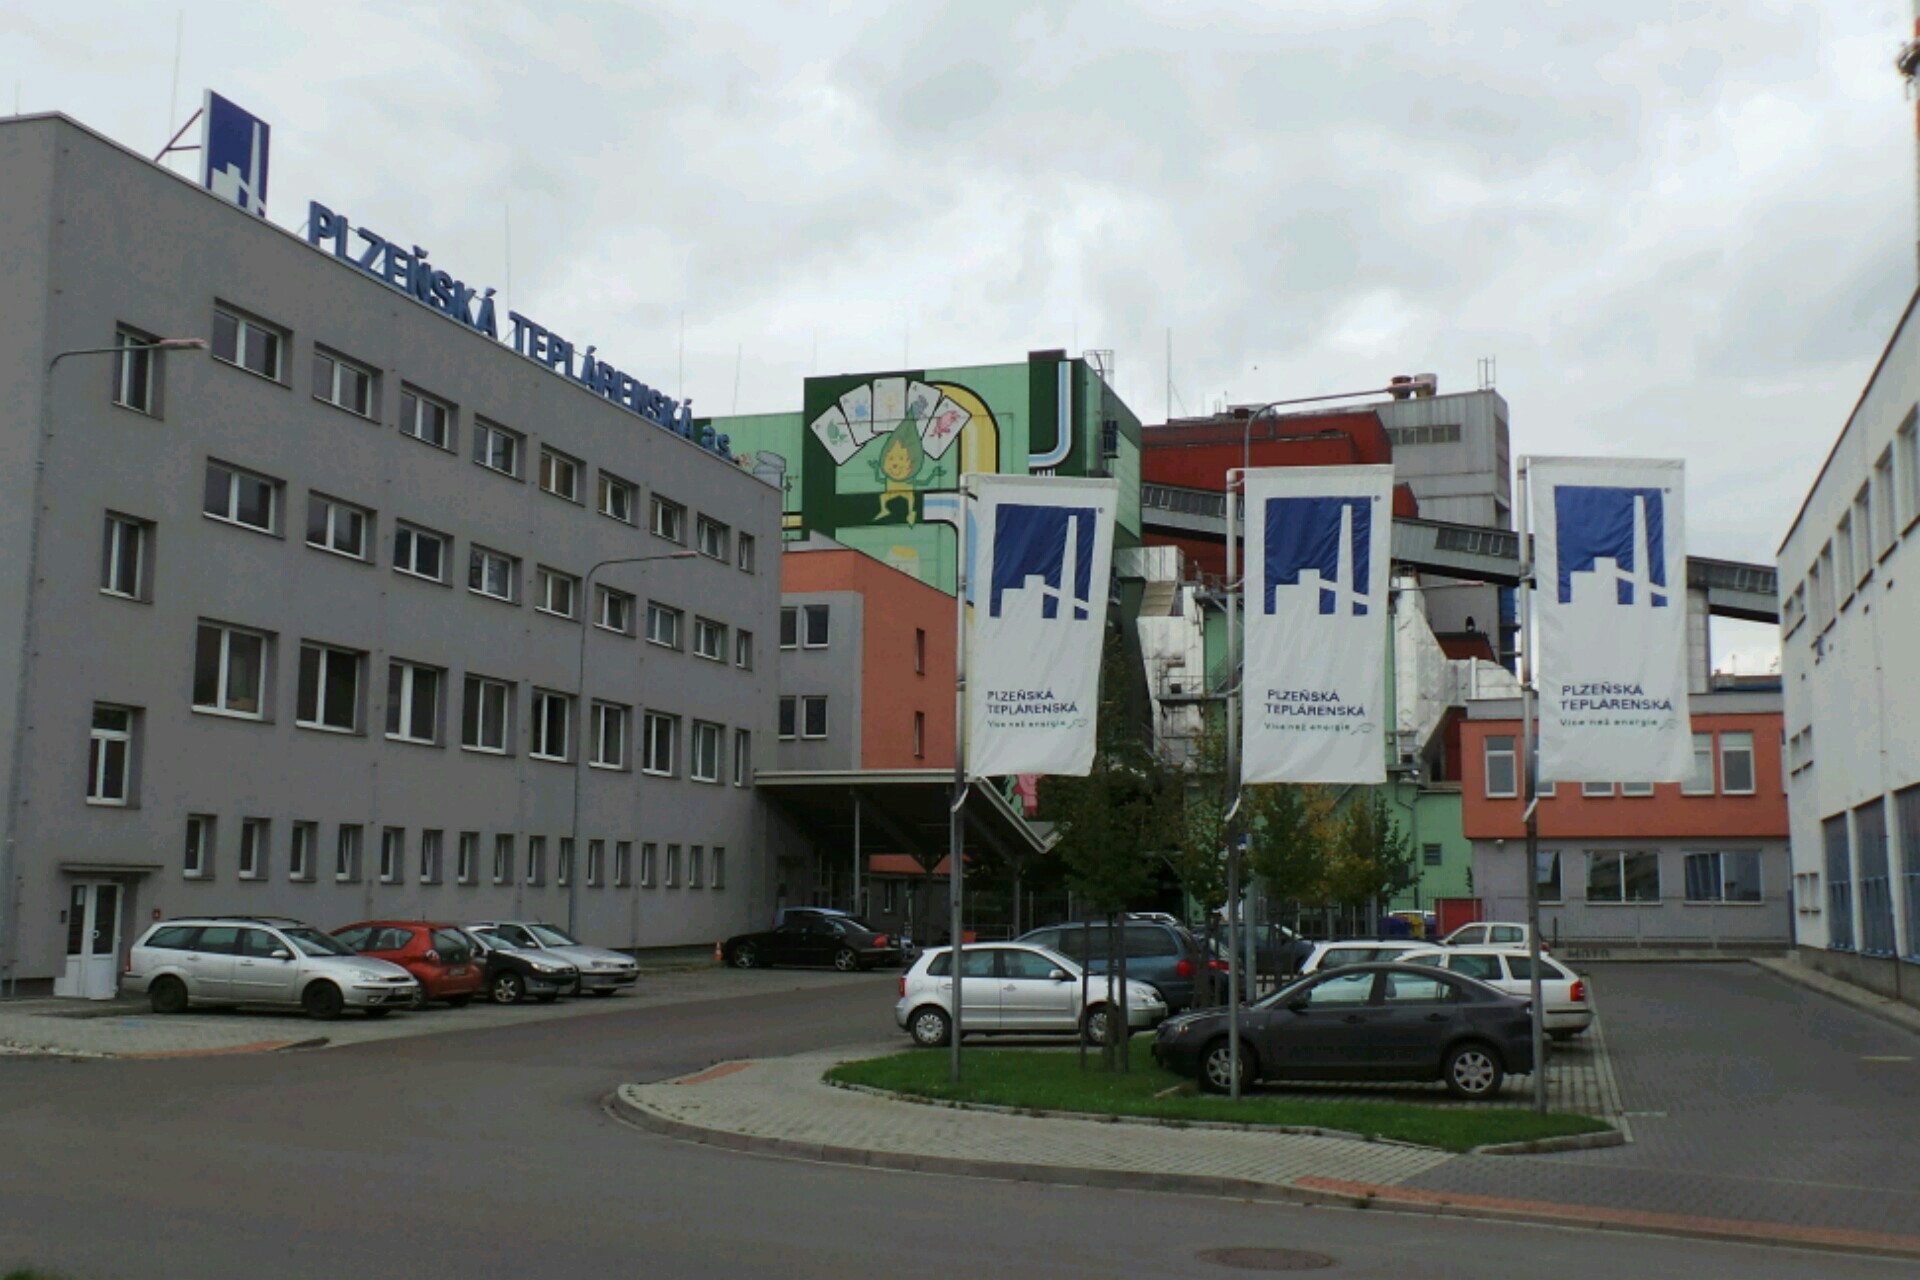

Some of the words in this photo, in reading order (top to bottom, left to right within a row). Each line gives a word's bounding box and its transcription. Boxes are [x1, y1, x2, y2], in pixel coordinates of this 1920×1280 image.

[308, 201, 498, 340] PLZEŇSKÁ
[508, 310, 693, 441] TEPLÁRENSKÁ
[987, 687, 1054, 701] PLZEŇSKÁ
[1267, 689, 1340, 702] PLZEŇSKÁ
[1562, 681, 1644, 696] PLZEŇSKÁ
[987, 701, 1078, 715] TEPLÁRENSKÁ
[1264, 703, 1365, 716] TEPLÁRENSKÁ
[1559, 697, 1672, 711] TEPLÁRENSKÁ
